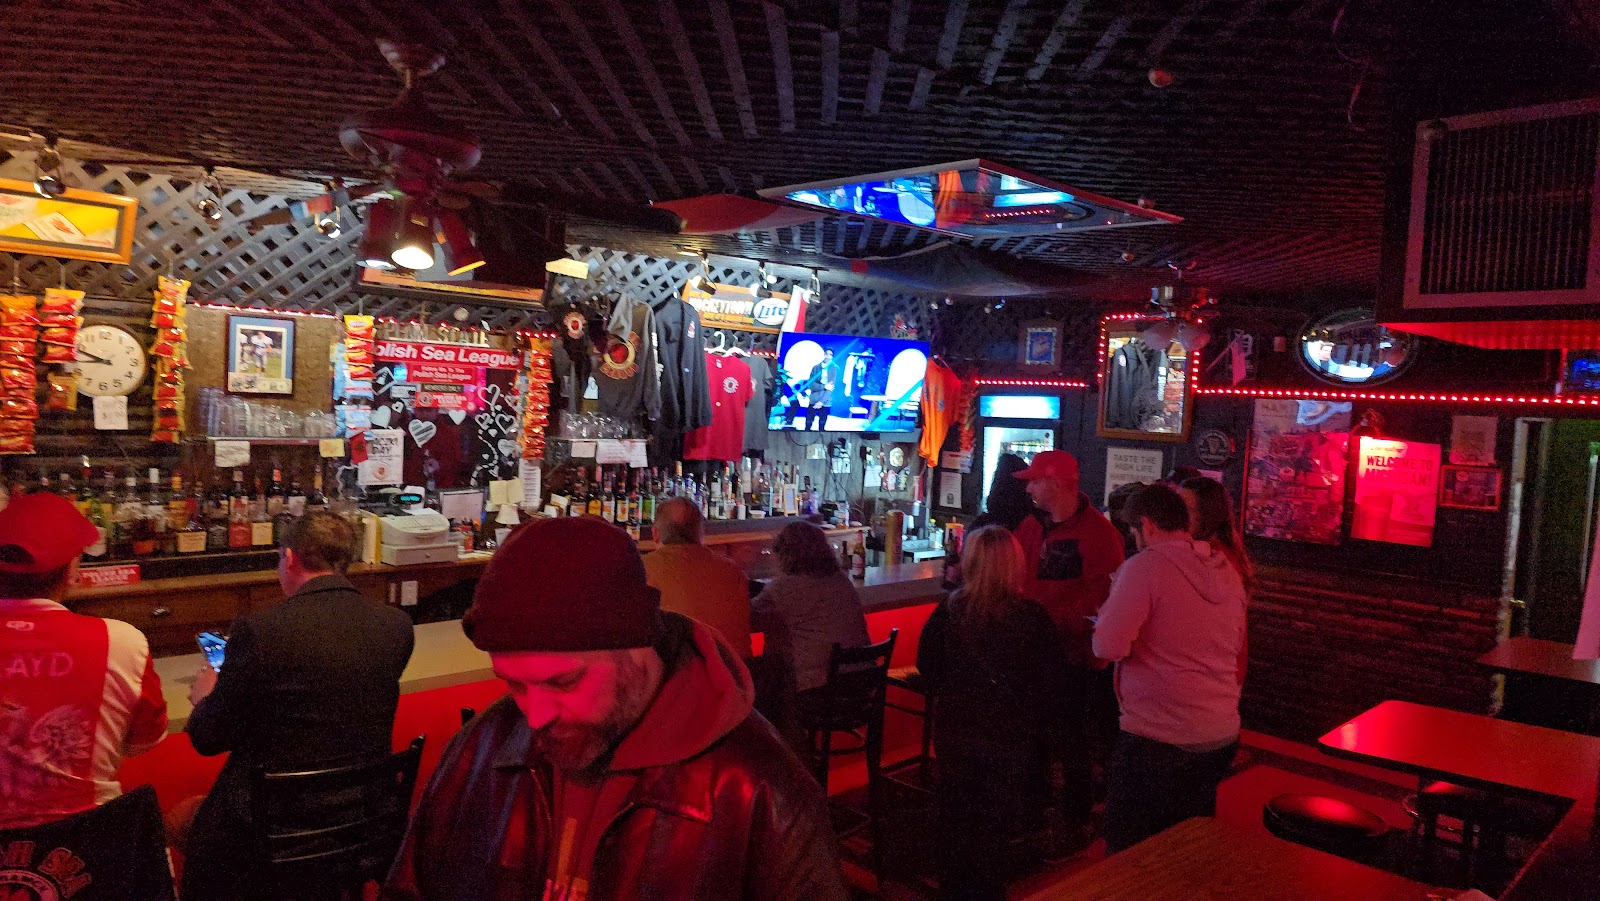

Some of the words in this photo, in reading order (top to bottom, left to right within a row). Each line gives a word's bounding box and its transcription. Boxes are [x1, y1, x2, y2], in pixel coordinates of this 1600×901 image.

[758, 305, 787, 319] Lite
[375, 342, 418, 359] olish
[421, 346, 456, 362] Sea
[458, 349, 520, 367] League
[1366, 455, 1417, 469] WELCOME
[1419, 459, 1433, 470] TO
[0, 651, 74, 678] AYD
